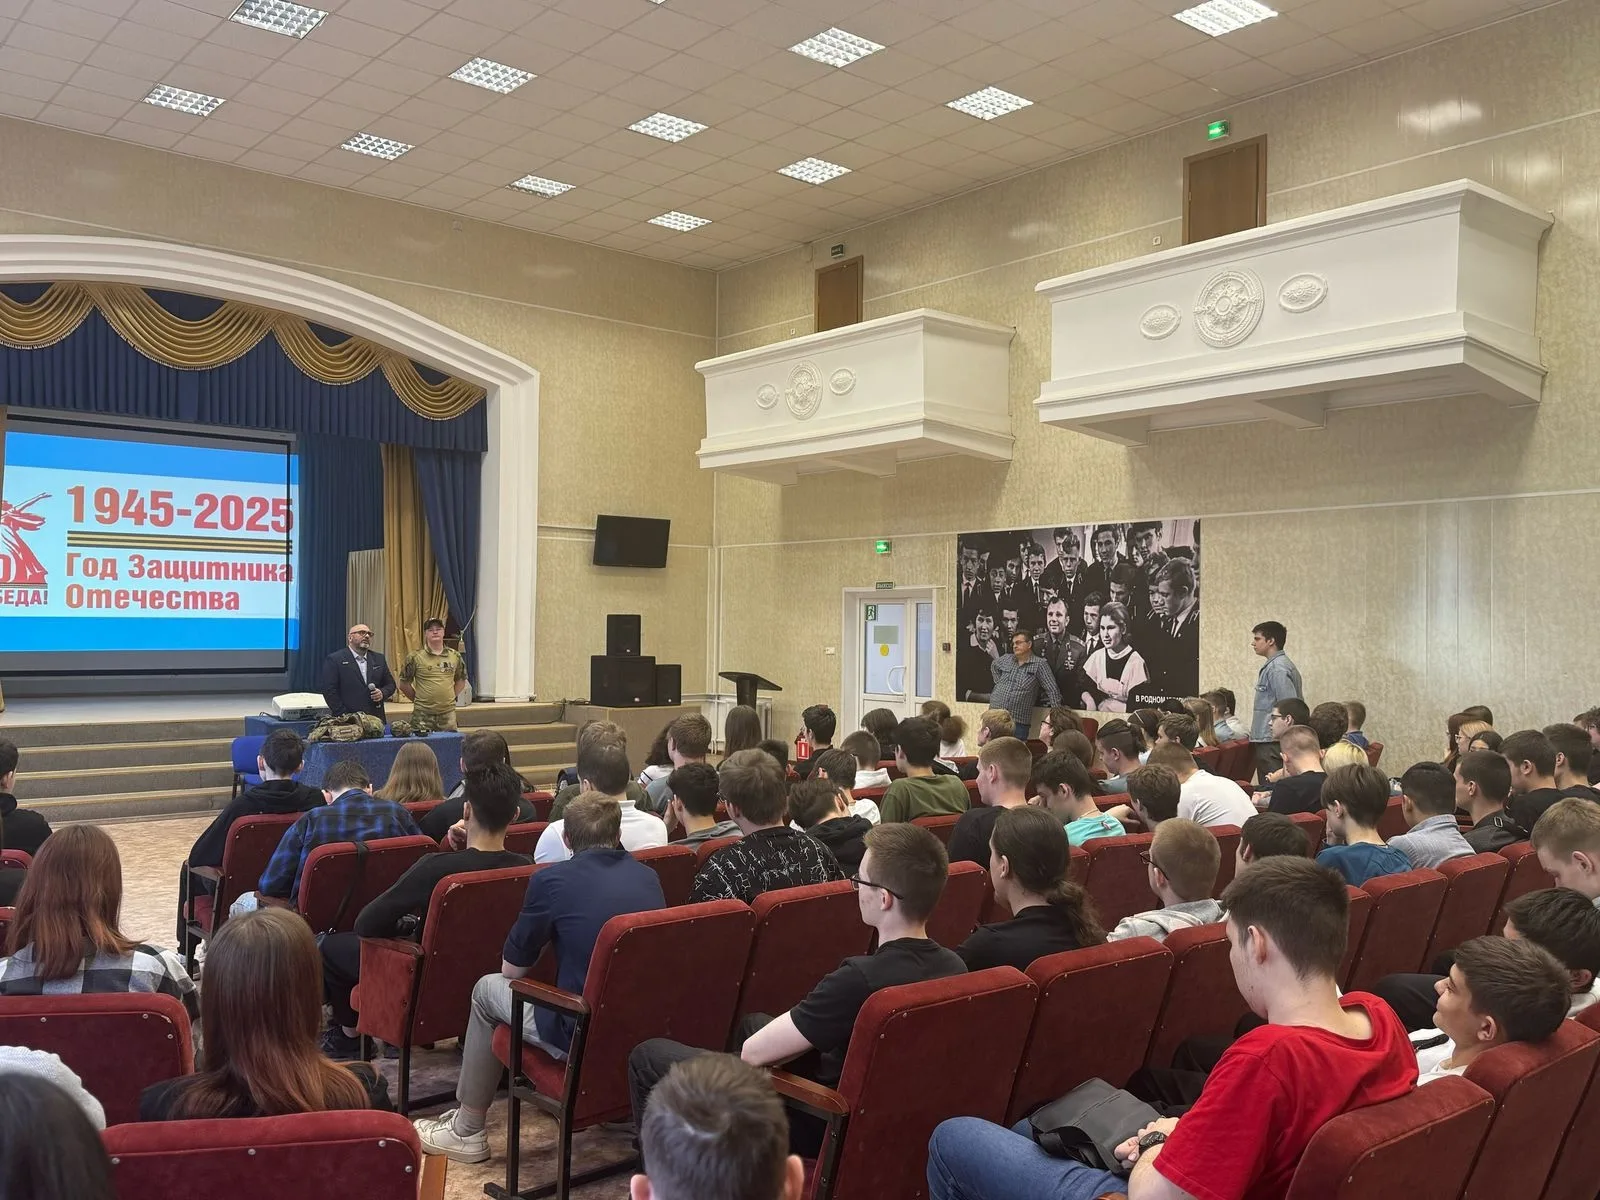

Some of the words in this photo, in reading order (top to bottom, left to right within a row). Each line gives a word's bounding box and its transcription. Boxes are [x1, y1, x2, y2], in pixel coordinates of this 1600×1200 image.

[66, 485, 294, 533] 1945-2025
[66, 552, 118, 580] Год
[128, 553, 294, 583] Защитника
[0, 589, 48, 607] ЕДА!
[65, 583, 240, 611] Отечества
[1140, 695, 1166, 704] РОДНОМ
